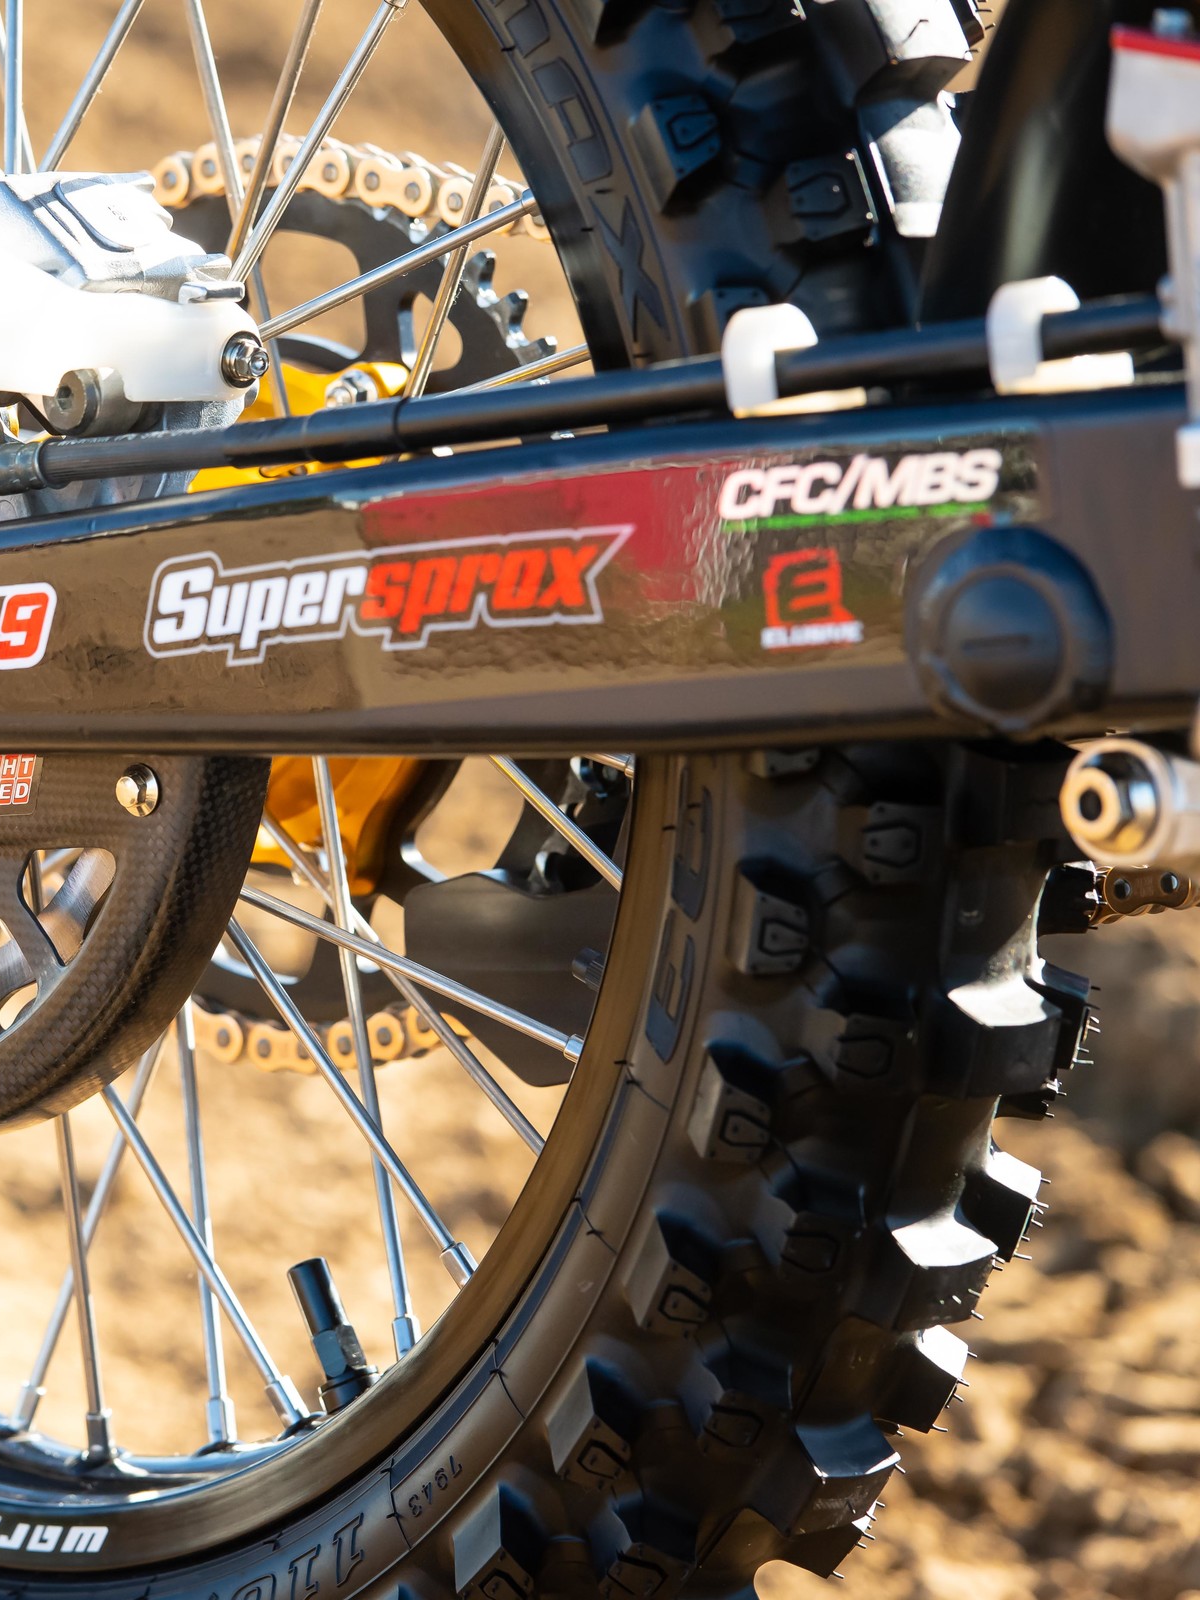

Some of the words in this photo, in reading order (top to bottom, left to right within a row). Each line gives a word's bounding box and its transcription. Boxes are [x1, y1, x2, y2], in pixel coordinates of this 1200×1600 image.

[718, 448, 1004, 520] CFC/MBS
[152, 545, 601, 651] Supersprox
[408, 1454, 463, 1518] 7943
